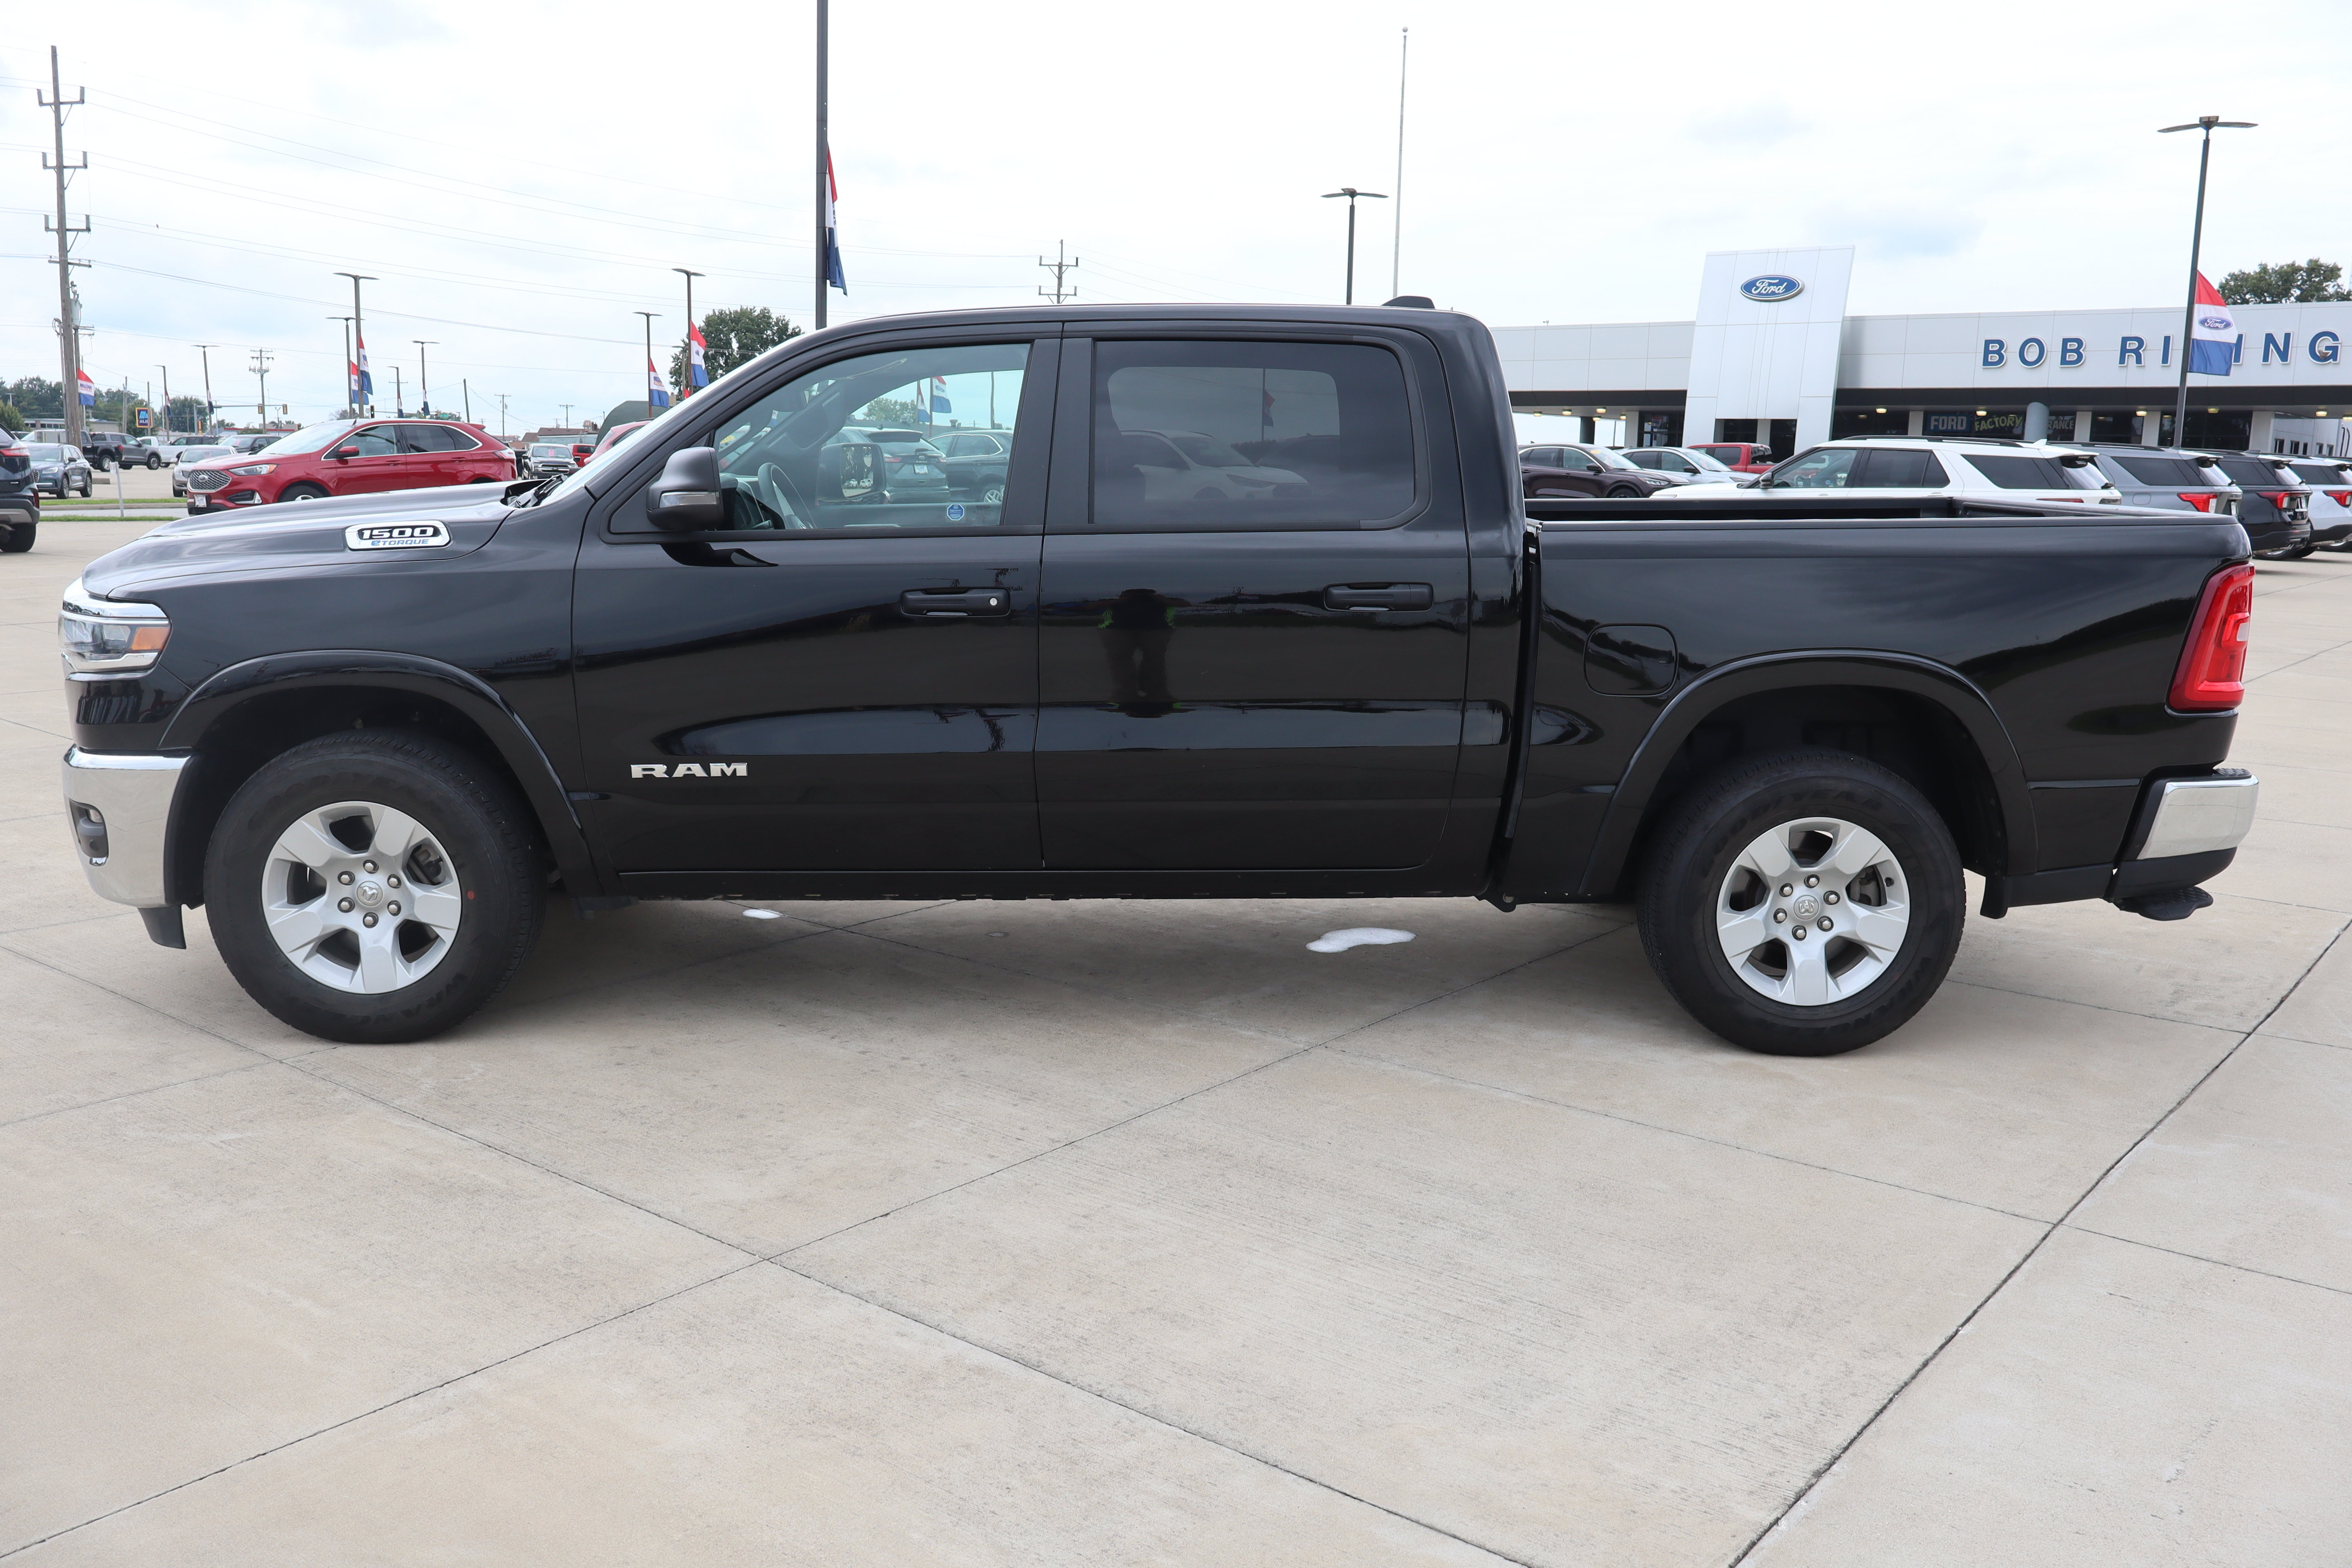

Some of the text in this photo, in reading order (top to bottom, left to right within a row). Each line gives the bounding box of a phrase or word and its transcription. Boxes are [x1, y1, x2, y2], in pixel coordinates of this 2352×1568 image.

[1751, 279, 1788, 294] Ford
[2205, 318, 2226, 328] Ford
[1982, 330, 2342, 368] BOB RIING
[1930, 416, 2074, 431] FORD FACTORY RANCE
[362, 527, 434, 539] 1500
[630, 762, 748, 779] RAM
[1701, 789, 1884, 878] GOODYEAR
